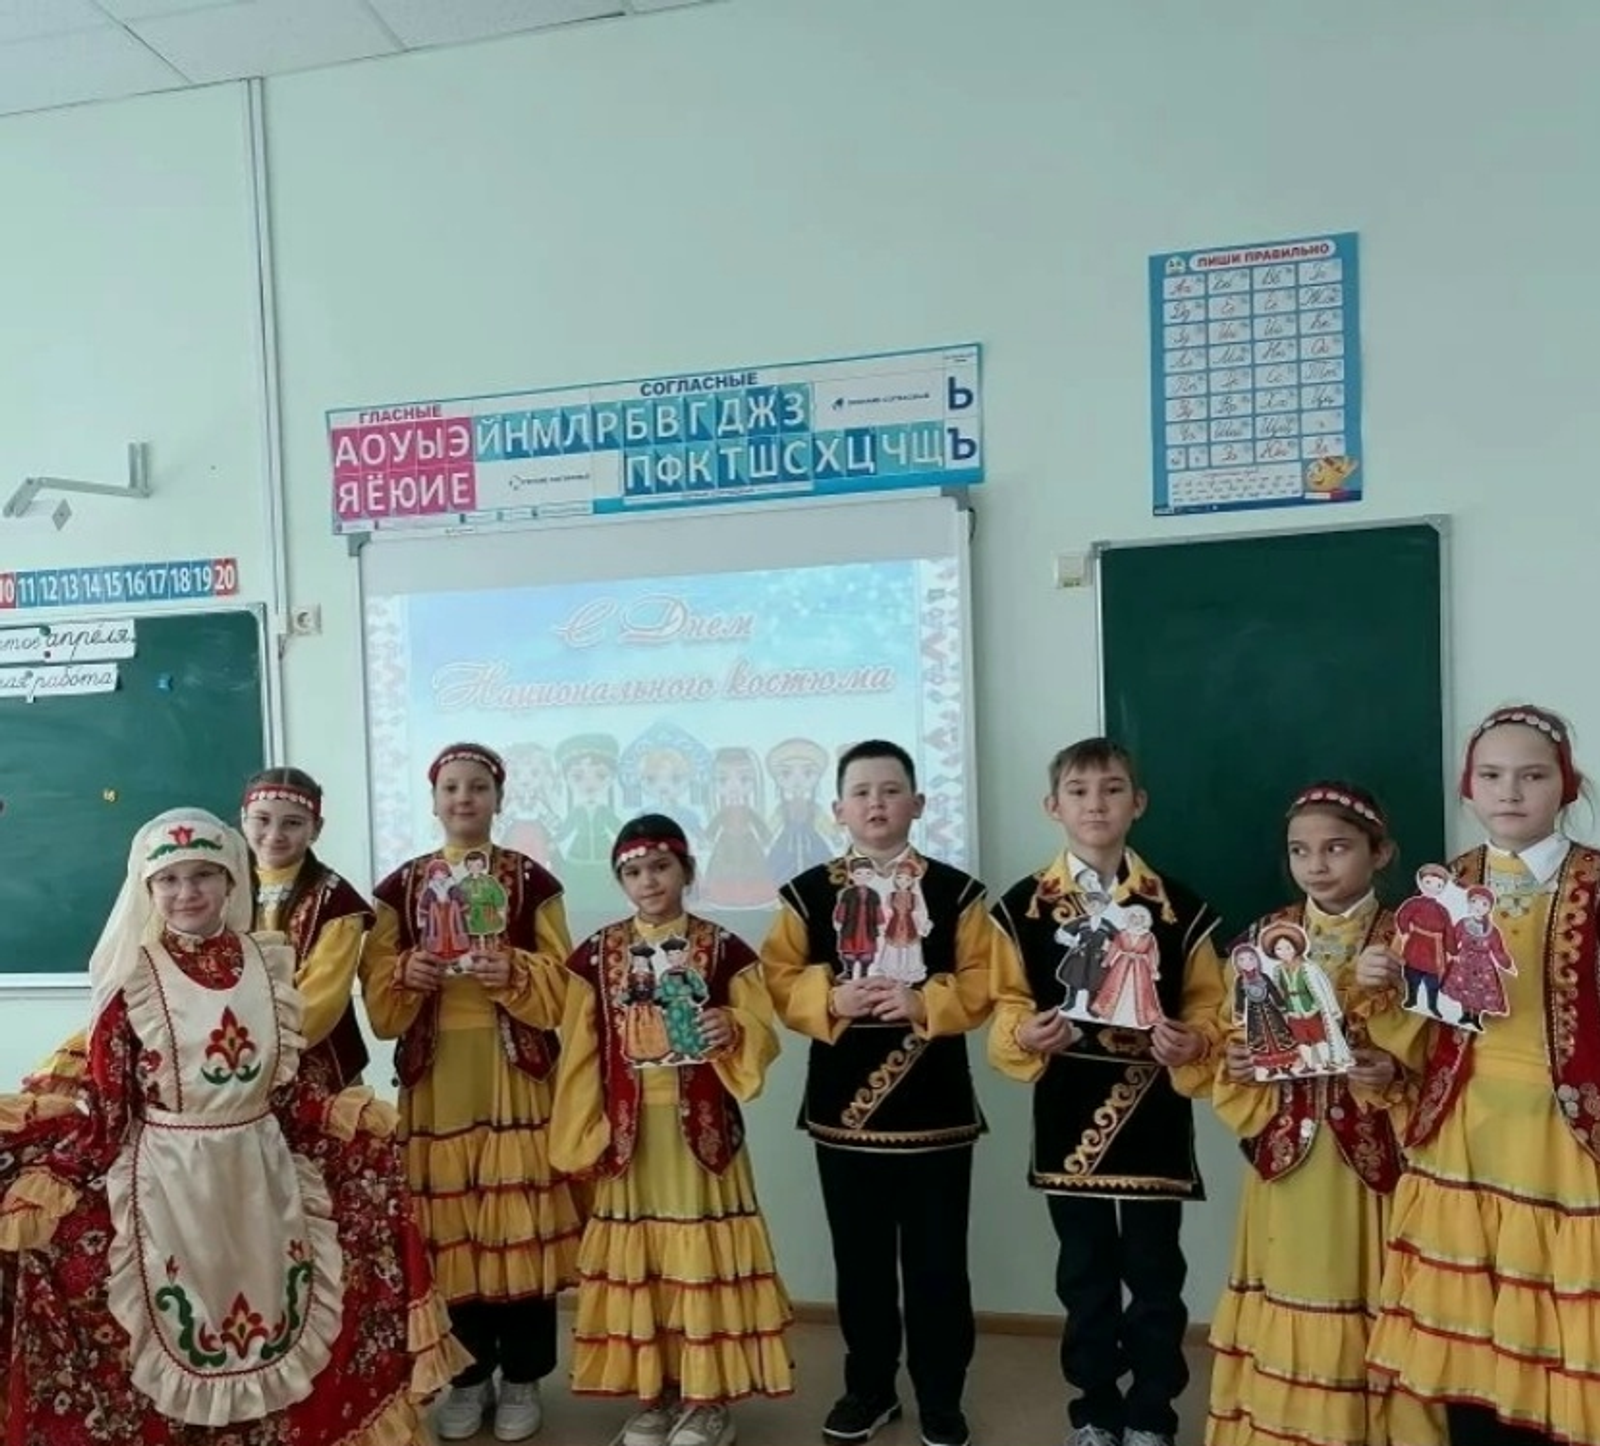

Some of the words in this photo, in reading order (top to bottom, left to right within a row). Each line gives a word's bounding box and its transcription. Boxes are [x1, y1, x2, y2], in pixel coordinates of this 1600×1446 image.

[1197, 252, 1240, 267] ПИШИ
[1245, 243, 1330, 262] ПРАВИЛЬНО
[359, 404, 443, 424] ГЛАСНЫЕ
[640, 372, 758, 397] СОГЛАСНЫЕ
[18, 577, 35, 603] 11
[39, 575, 58, 600] 12
[61, 573, 79, 599] 13
[82, 573, 101, 598] 14
[104, 571, 122, 597] 15
[125, 571, 146, 596] 16
[147, 569, 167, 594] 17
[169, 568, 190, 593] 18
[192, 566, 212, 592] 19
[215, 565, 235, 590] 20
